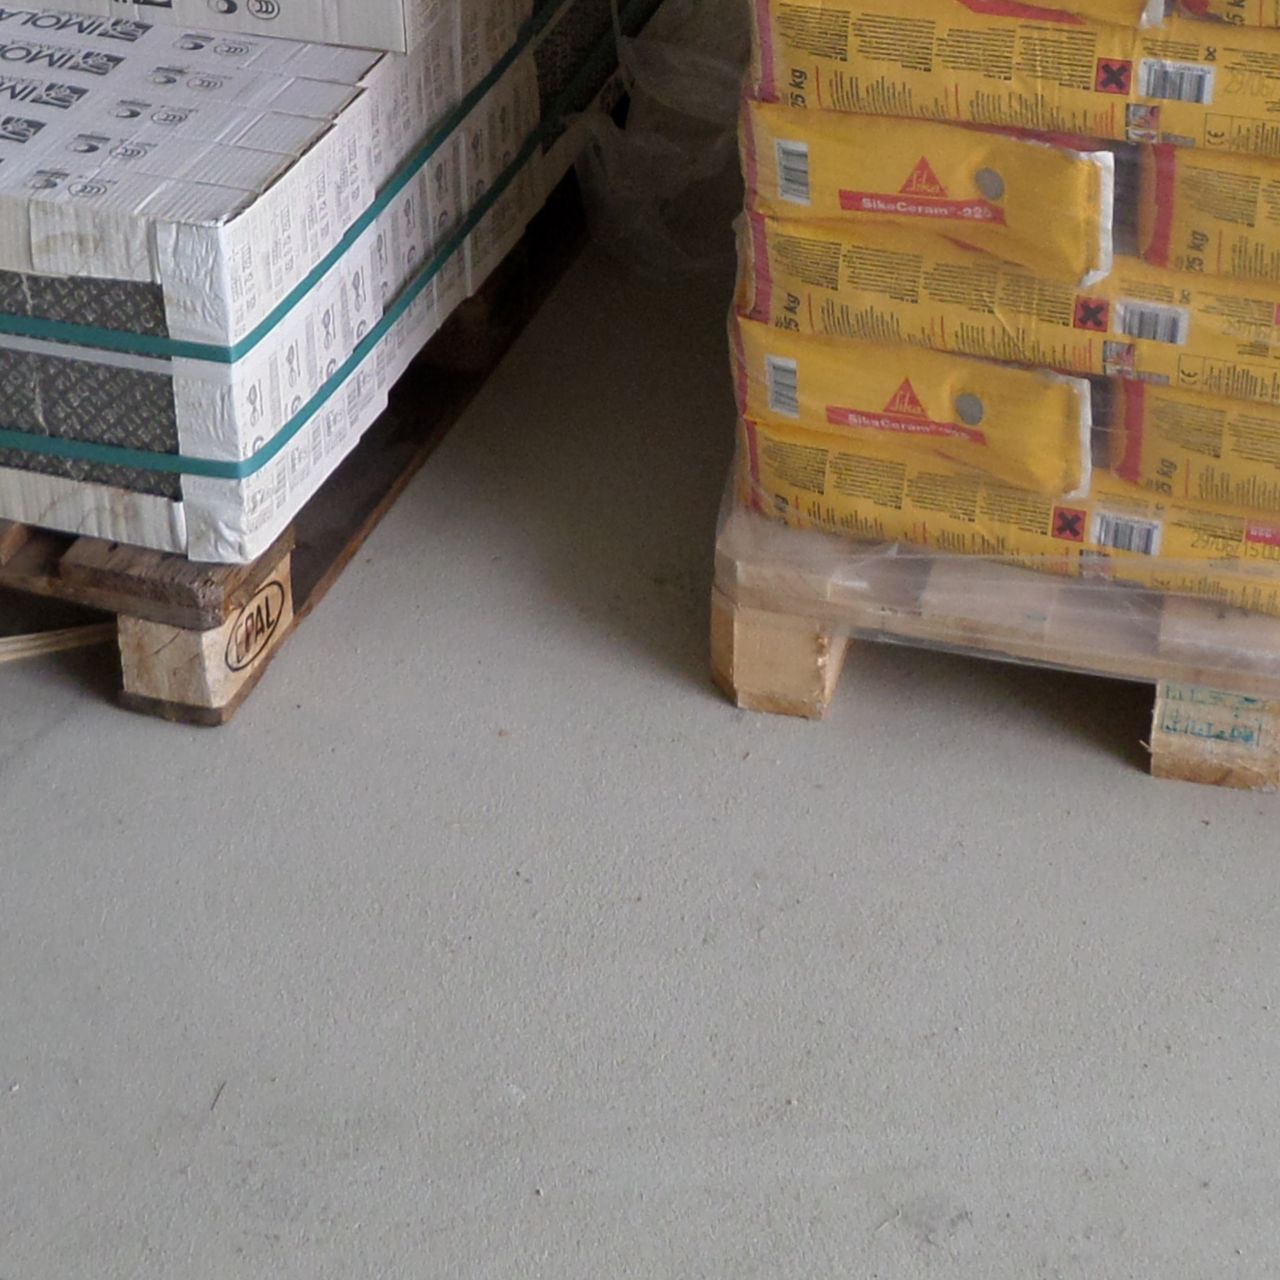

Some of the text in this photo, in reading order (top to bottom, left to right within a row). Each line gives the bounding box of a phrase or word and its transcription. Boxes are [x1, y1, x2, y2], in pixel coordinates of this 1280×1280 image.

[788, 67, 808, 90] kg
[906, 170, 942, 194] Sika
[1186, 229, 1210, 252] kg
[783, 291, 801, 316] kg
[890, 391, 924, 413] Sika
[1155, 458, 1178, 480] kg
